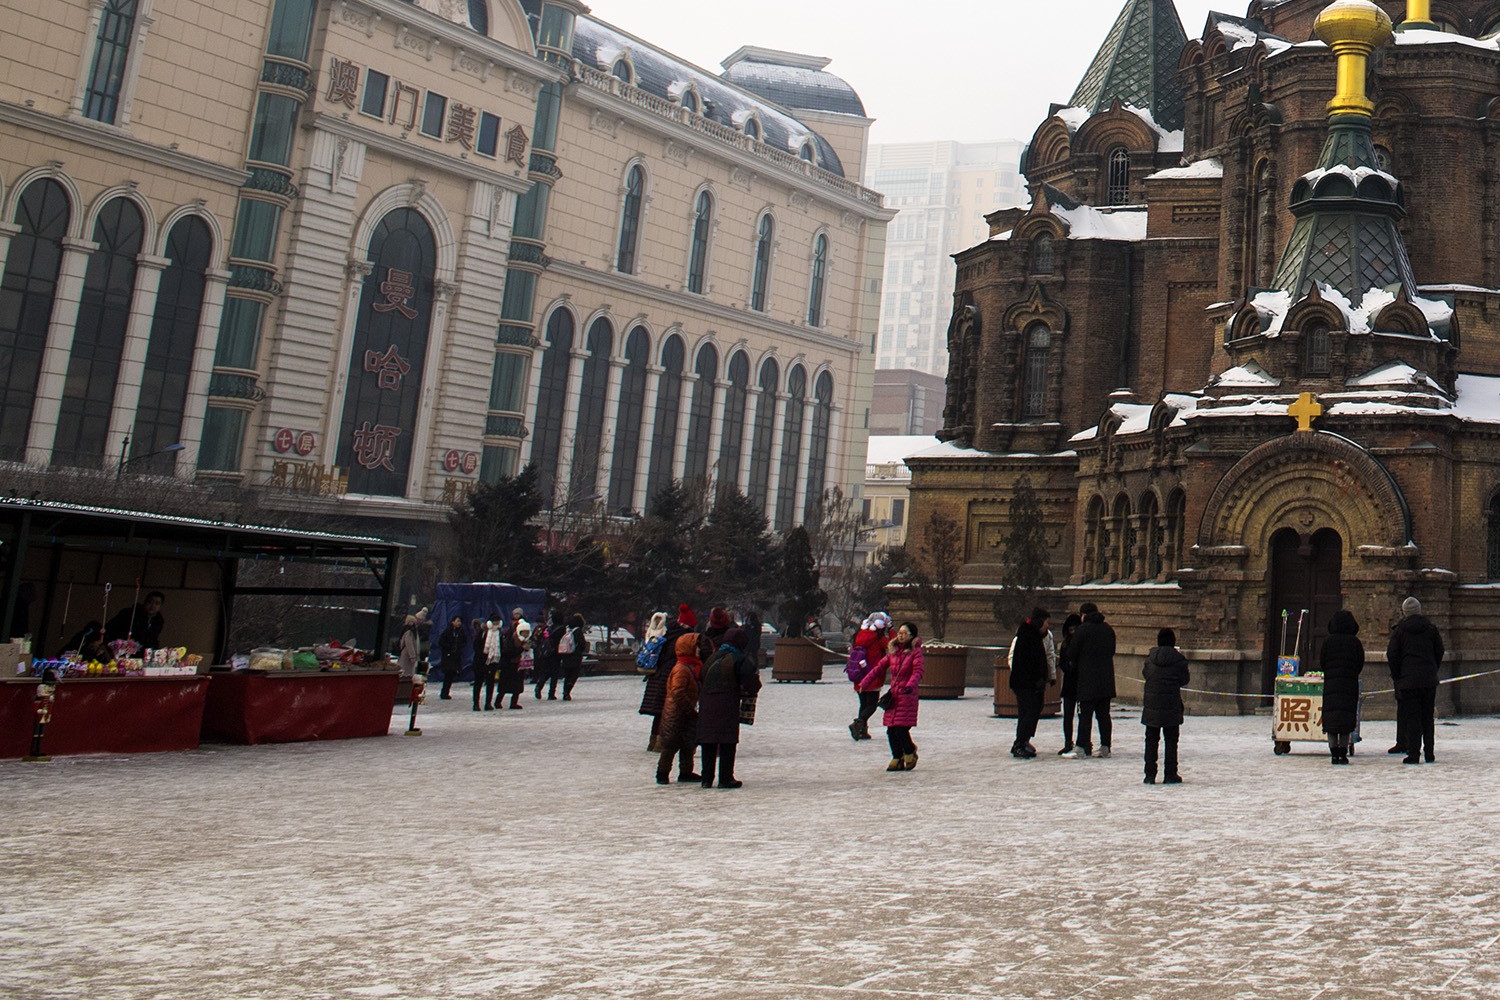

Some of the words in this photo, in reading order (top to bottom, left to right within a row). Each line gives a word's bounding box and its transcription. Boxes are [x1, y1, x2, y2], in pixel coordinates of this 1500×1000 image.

[326, 57, 529, 168] 澳门美食
[353, 268, 418, 471] 曼哈顿
[277, 430, 313, 453] 七层
[446, 453, 478, 471] 七层
